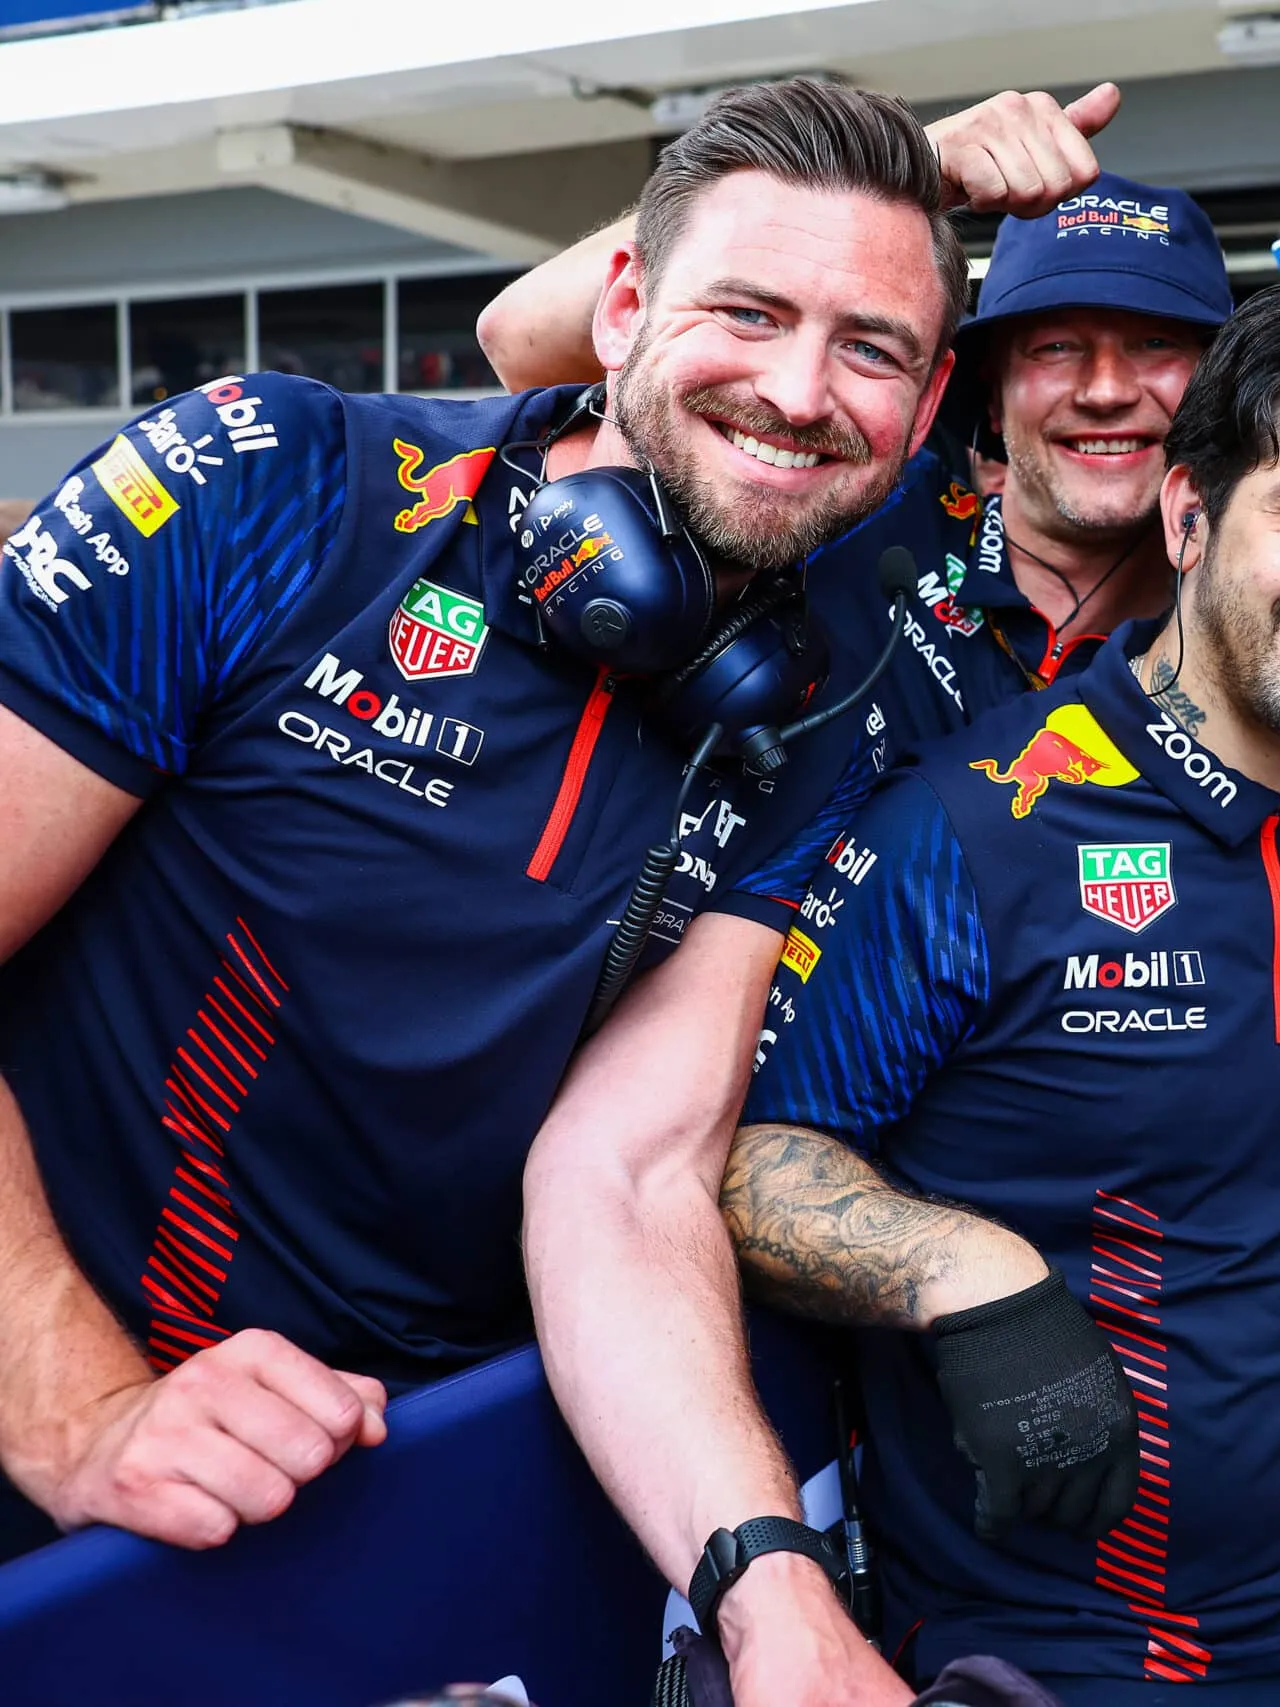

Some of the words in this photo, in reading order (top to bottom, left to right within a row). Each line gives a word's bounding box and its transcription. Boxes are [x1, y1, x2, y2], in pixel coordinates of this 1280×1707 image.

[1057, 195, 1169, 221] ORACLE
[1057, 210, 1086, 229] Red
[1088, 210, 1118, 224] Bull
[1056, 228, 1170, 246] RACING
[525, 513, 604, 585] ORACLE
[533, 574, 554, 603] Red
[549, 557, 575, 587] Bull
[544, 549, 625, 617] RACING
[303, 653, 433, 748] Mobil
[277, 711, 455, 808] ORACLE
[1145, 712, 1237, 808] zoom
[826, 831, 877, 886] obil
[1085, 849, 1162, 877] TAG
[801, 887, 832, 929] aro
[1087, 882, 1169, 929] HEUER
[1063, 953, 1168, 990] Mobil
[1060, 1007, 1208, 1034] ORACLE
